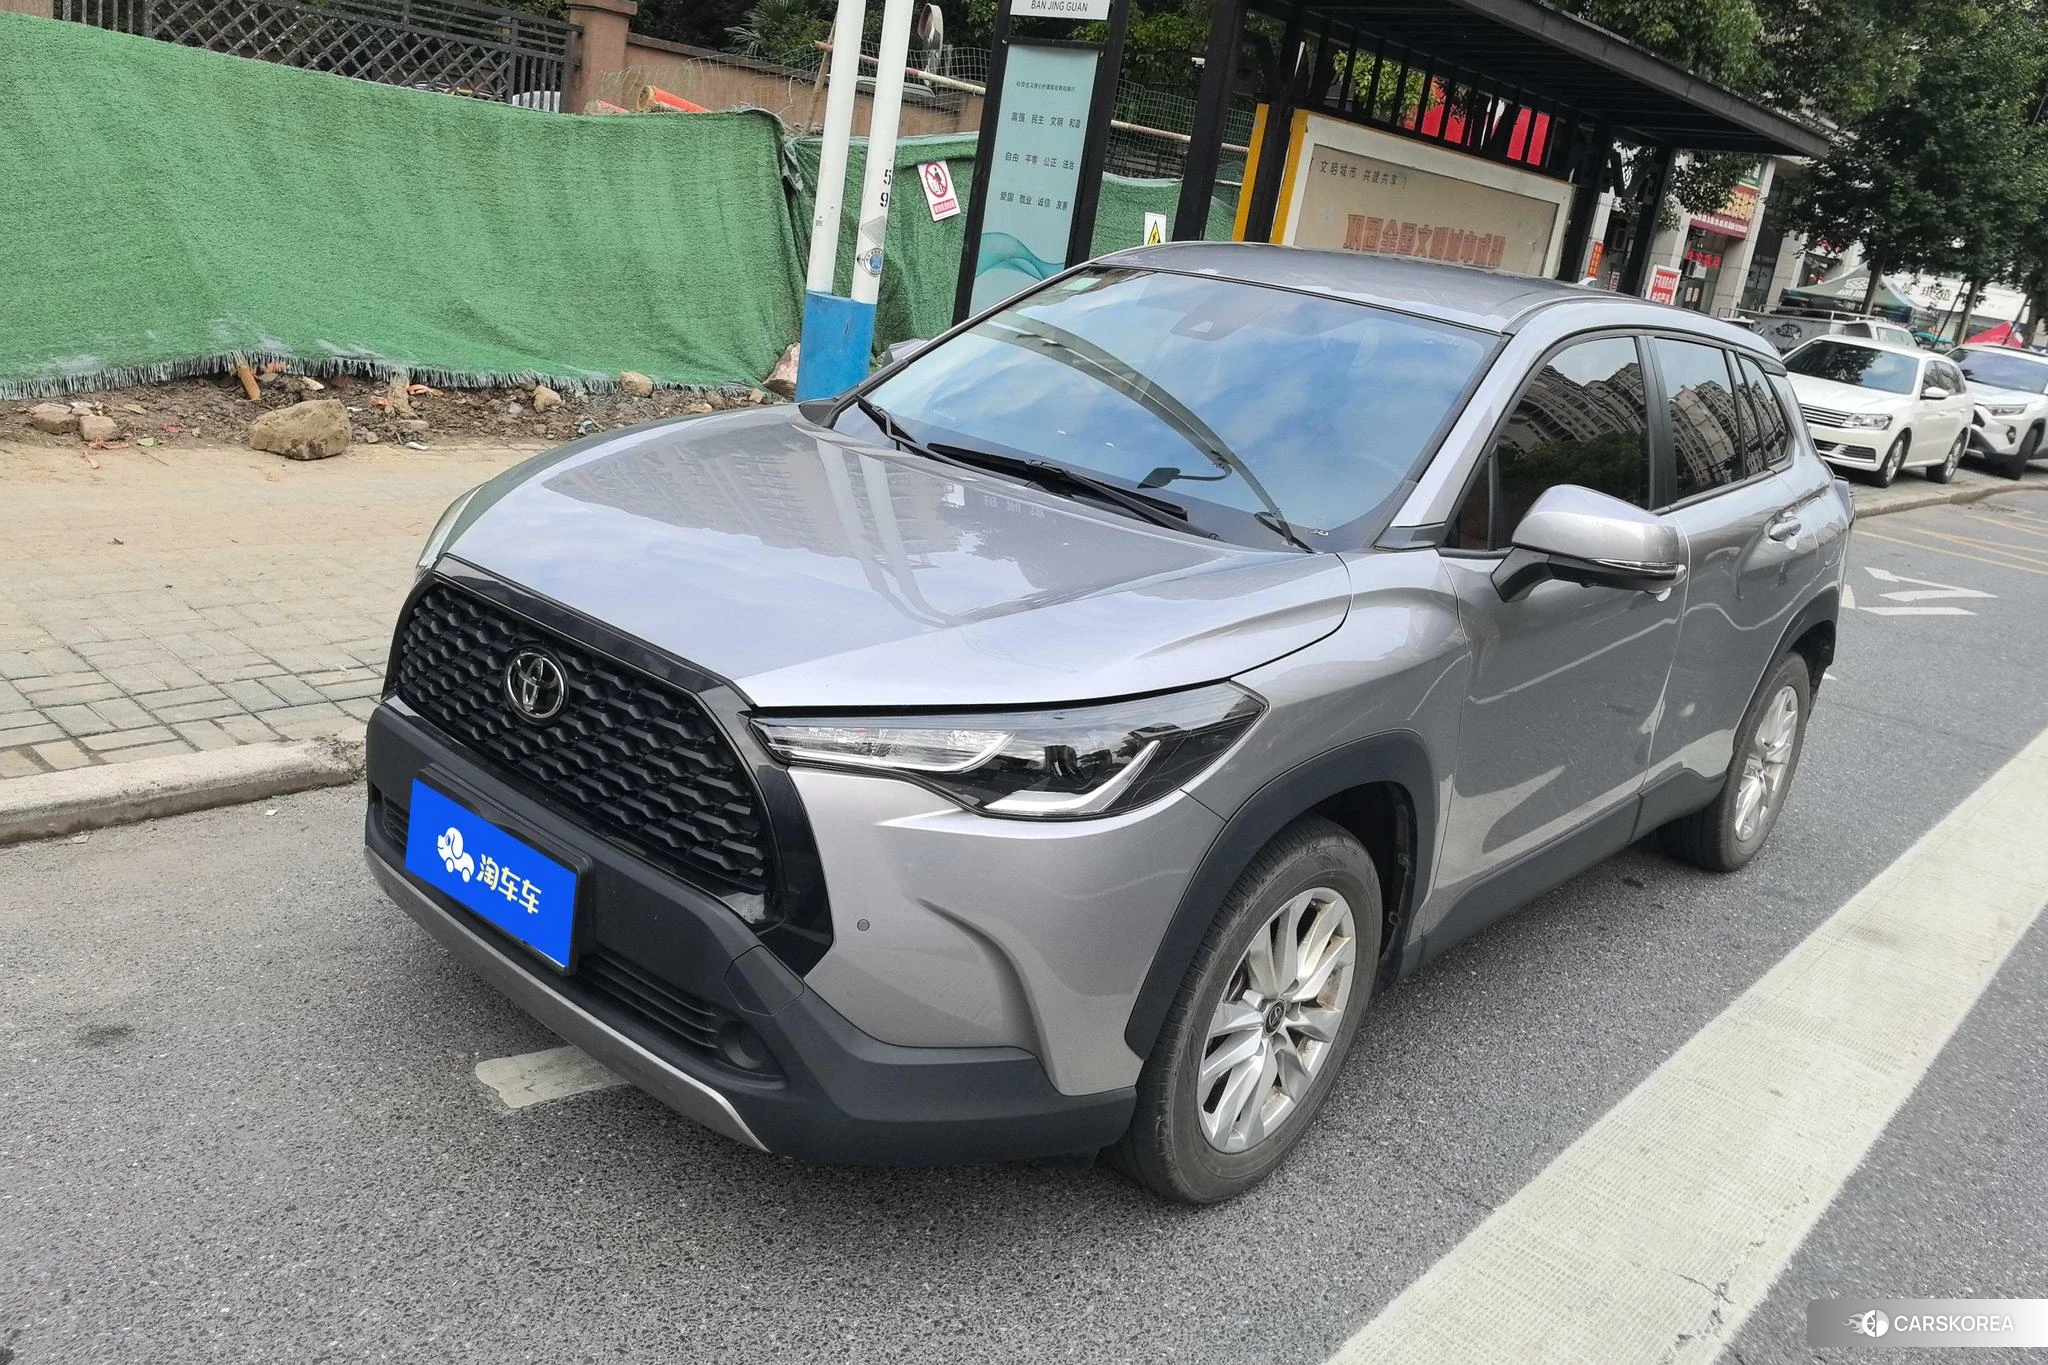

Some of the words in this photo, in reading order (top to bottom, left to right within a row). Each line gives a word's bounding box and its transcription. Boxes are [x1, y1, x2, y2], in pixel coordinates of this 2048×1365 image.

[1031, 0, 1046, 10] BAN
[1048, 1, 1064, 11] JING
[1066, 2, 1088, 12] GUAN
[1011, 112, 1025, 122] 富强
[1032, 114, 1044, 125] 民主
[1050, 116, 1063, 127] 文明
[1069, 118, 1080, 128] 和谐
[1005, 152, 1019, 162] 自由
[1025, 154, 1037, 165] 平等
[1044, 157, 1057, 168] 公正
[1062, 159, 1074, 170] 法治
[1320, 160, 1357, 178] 文明城市
[1363, 169, 1398, 187] 共建共享
[1000, 191, 1014, 202] 爱国
[1020, 194, 1031, 205] 敬业
[1038, 197, 1050, 208] 诚信
[1056, 200, 1068, 211] 友善
